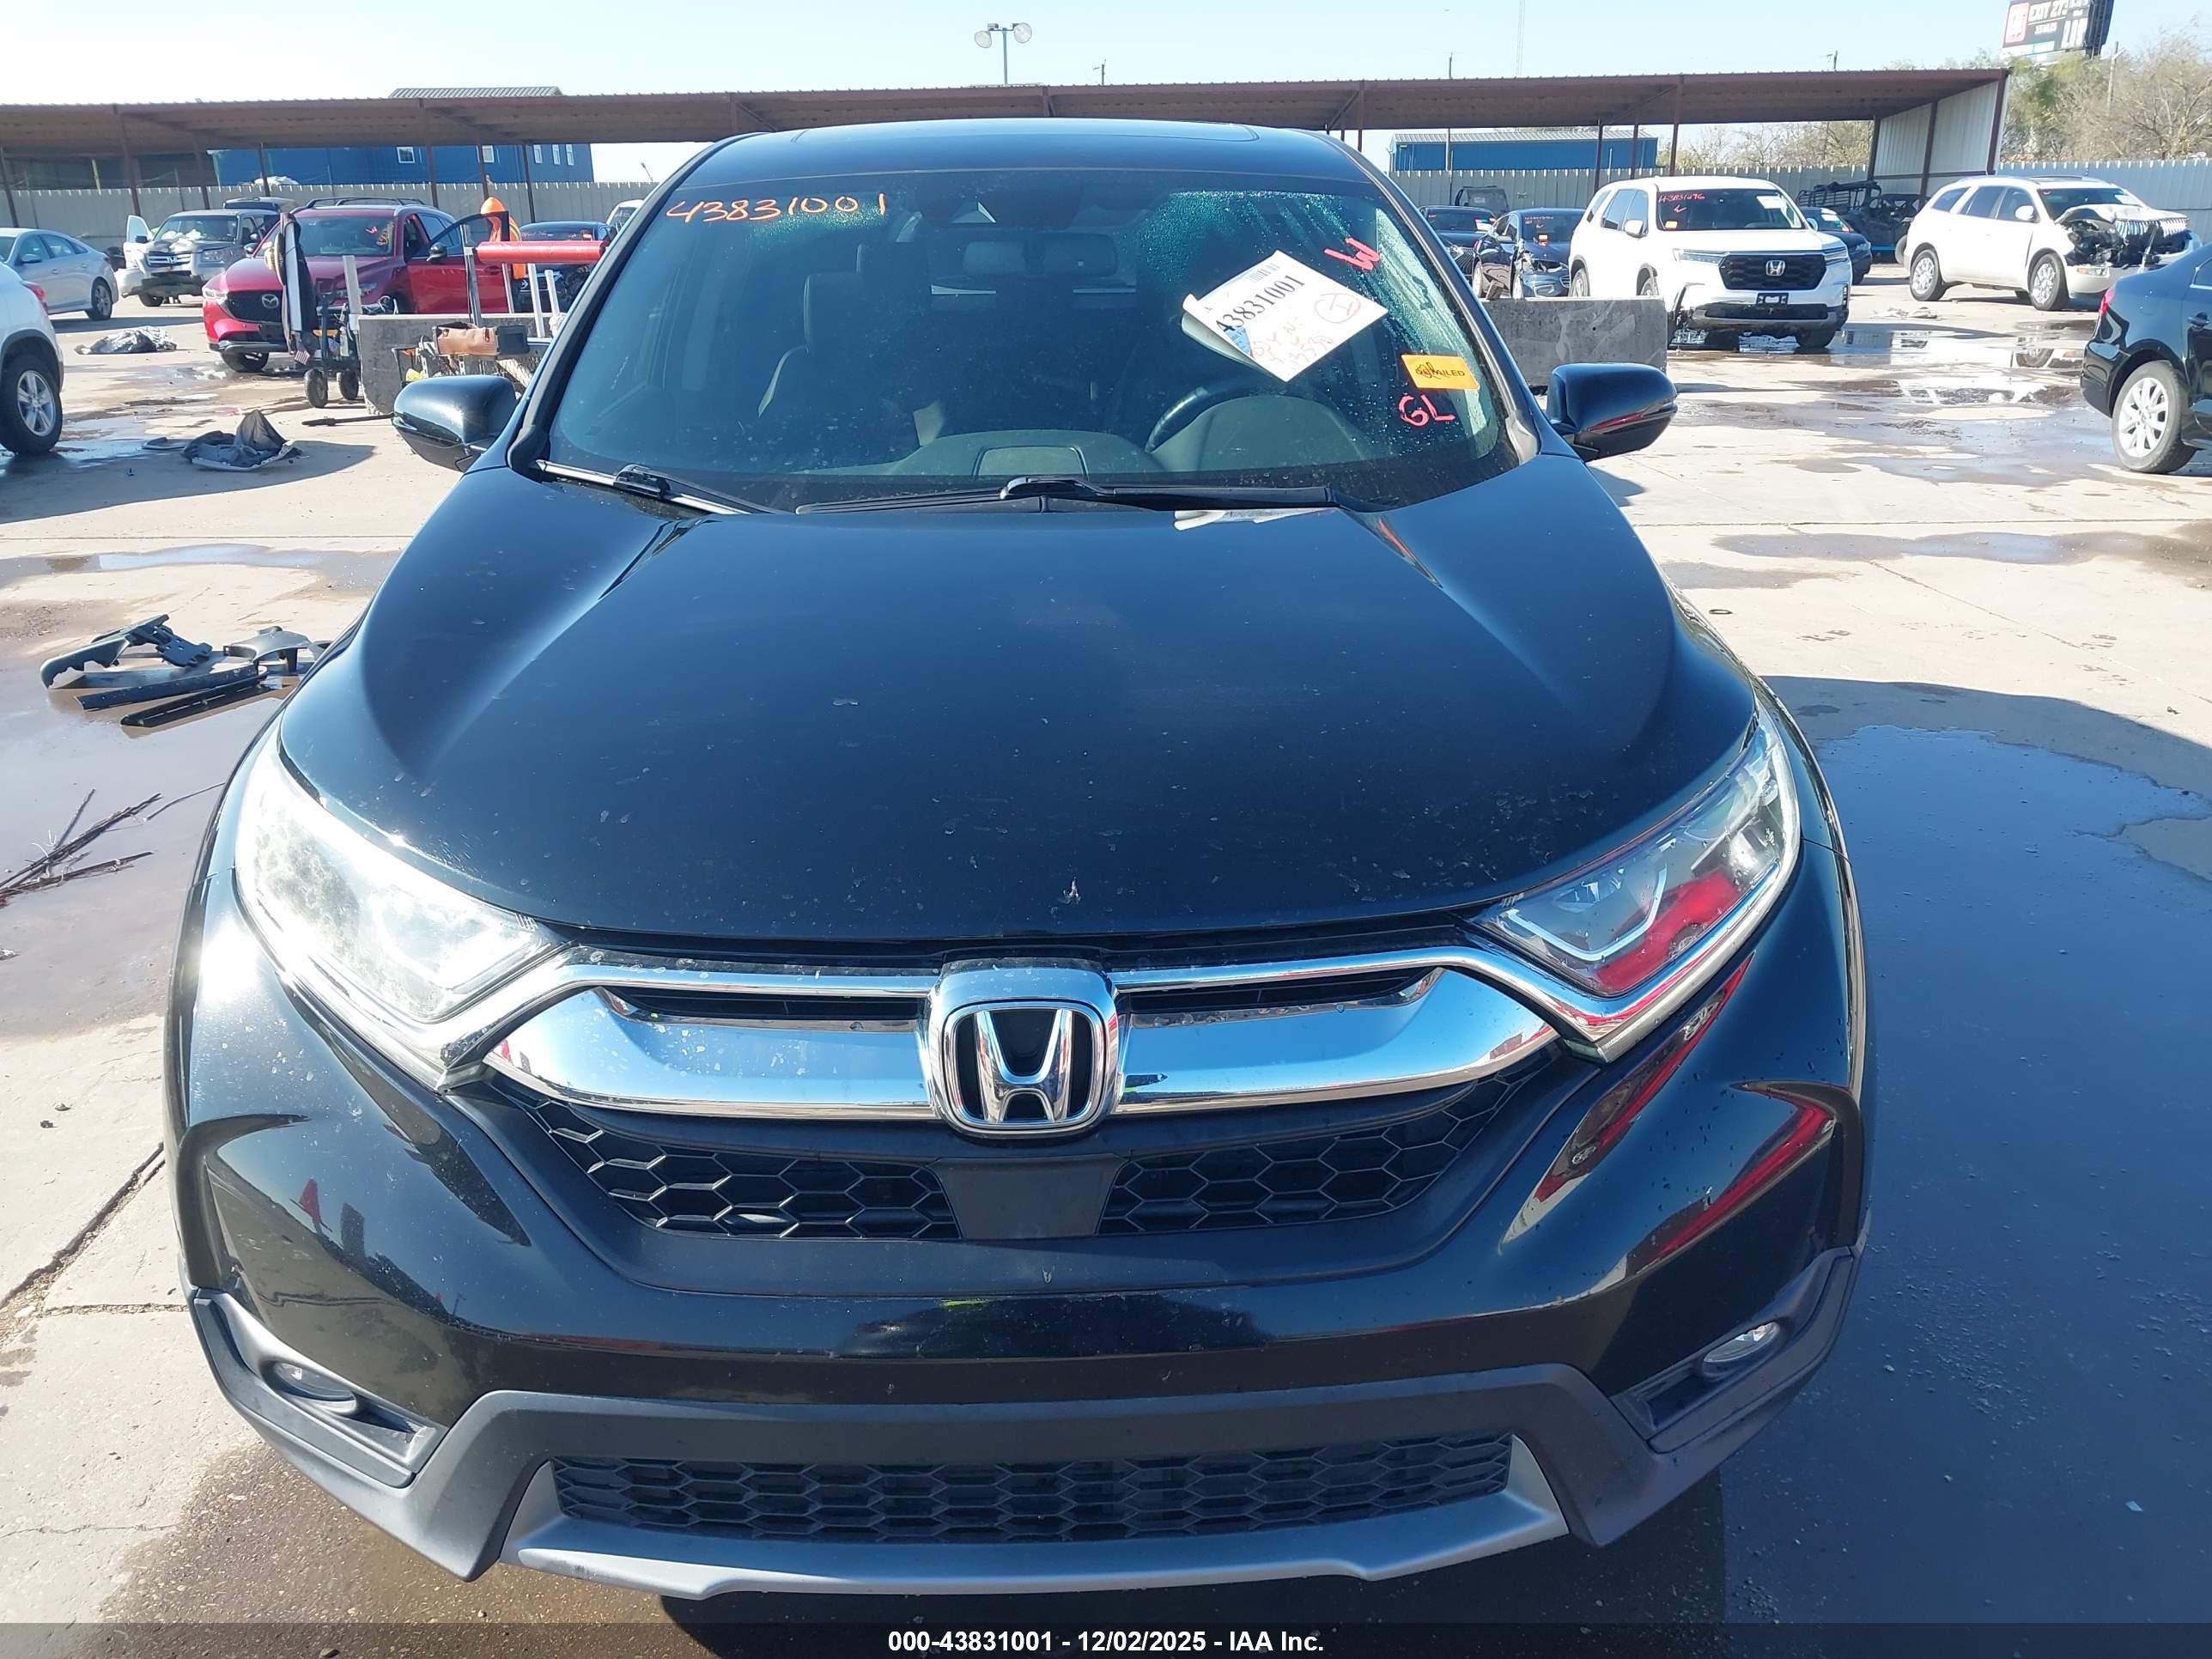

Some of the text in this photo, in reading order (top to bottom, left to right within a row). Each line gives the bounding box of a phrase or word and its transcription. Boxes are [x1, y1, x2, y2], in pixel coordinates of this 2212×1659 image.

[666, 192, 885, 222] 43831001
[1215, 275, 1306, 333] 43831001
[1398, 394, 1455, 426] GL
[974, 1008, 1073, 1124] H
